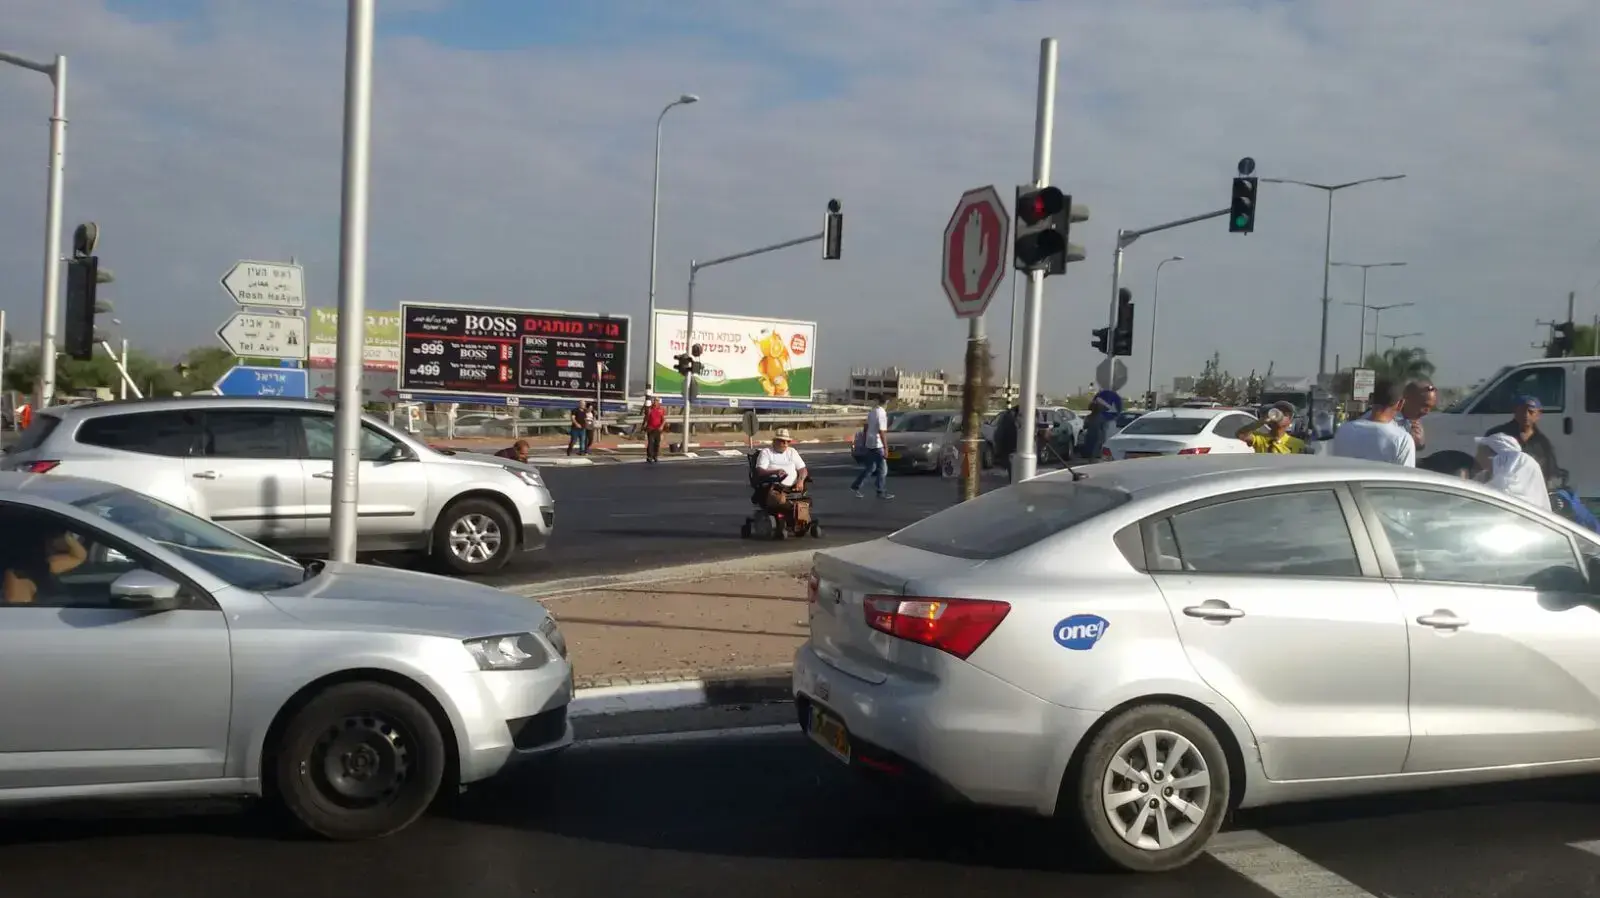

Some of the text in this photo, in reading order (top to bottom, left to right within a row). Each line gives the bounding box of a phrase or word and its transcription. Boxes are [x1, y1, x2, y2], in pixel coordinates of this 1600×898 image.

[239, 290, 300, 303] Rosh HaAyin
[240, 318, 262, 328] אביב
[465, 315, 518, 332] BOSS
[524, 319, 584, 335] מותגים
[525, 337, 548, 346] BOSS
[556, 341, 587, 349] PRADA
[239, 342, 280, 352] Tel Aviv
[733, 344, 747, 354] על
[459, 348, 488, 358] BOSS
[254, 370, 286, 382] אריאל
[459, 368, 487, 377] BOSS
[524, 379, 567, 387] PHILIPP
